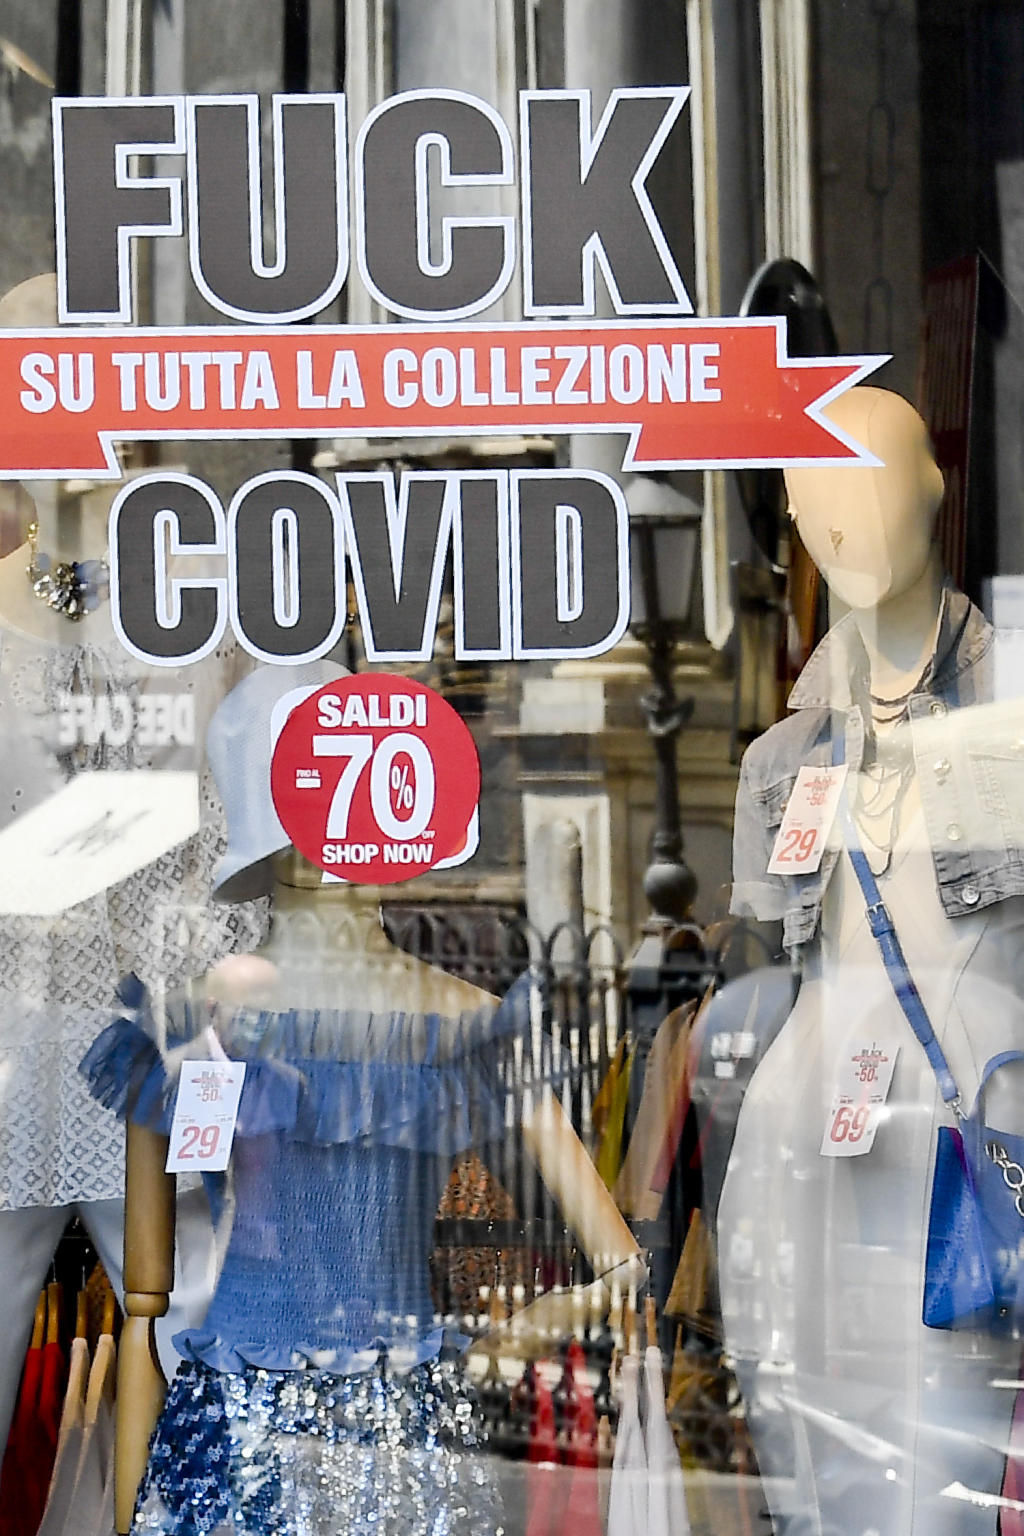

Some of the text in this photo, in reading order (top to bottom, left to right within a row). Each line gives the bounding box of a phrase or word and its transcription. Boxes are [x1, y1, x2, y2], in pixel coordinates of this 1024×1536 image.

[52, 86, 694, 325] FUCK
[19, 343, 721, 413] SU TUTTA LA COLLEZIONE
[109, 468, 630, 667] COVID
[317, 694, 428, 728] SALDI
[322, 843, 434, 864] SHOP NOW
[776, 829, 818, 862] 29
[177, 1125, 220, 1160] 29
[830, 1106, 870, 1143] 69
